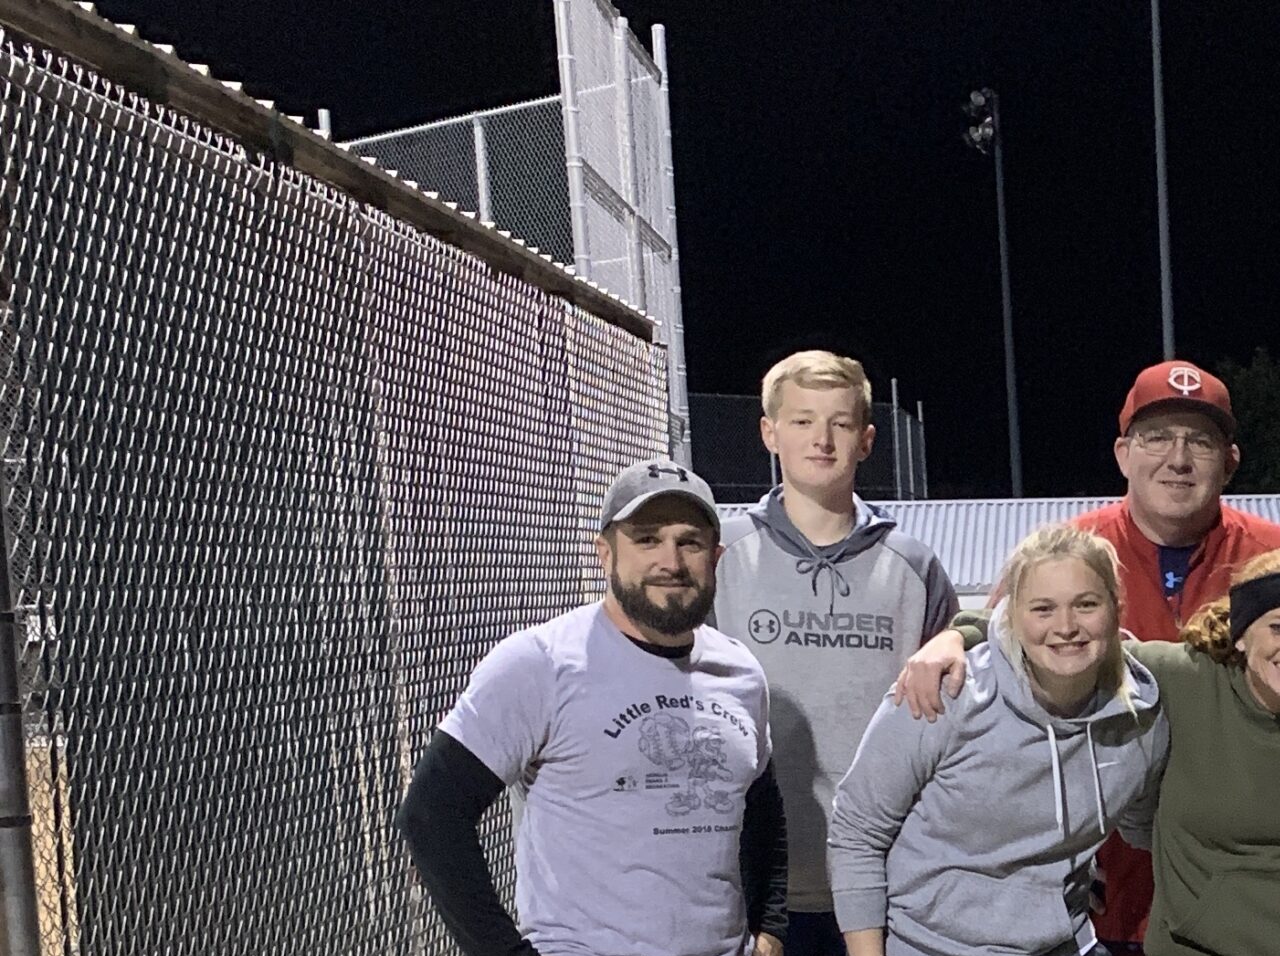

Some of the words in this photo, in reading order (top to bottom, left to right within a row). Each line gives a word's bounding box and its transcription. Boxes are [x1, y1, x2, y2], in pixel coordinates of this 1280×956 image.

[783, 609, 894, 634] UNDER
[784, 631, 894, 651] ARMOUR
[603, 702, 652, 739] Little
[655, 694, 705, 711] Red's
[711, 702, 749, 737] Crew
[653, 827, 690, 836] Summer
